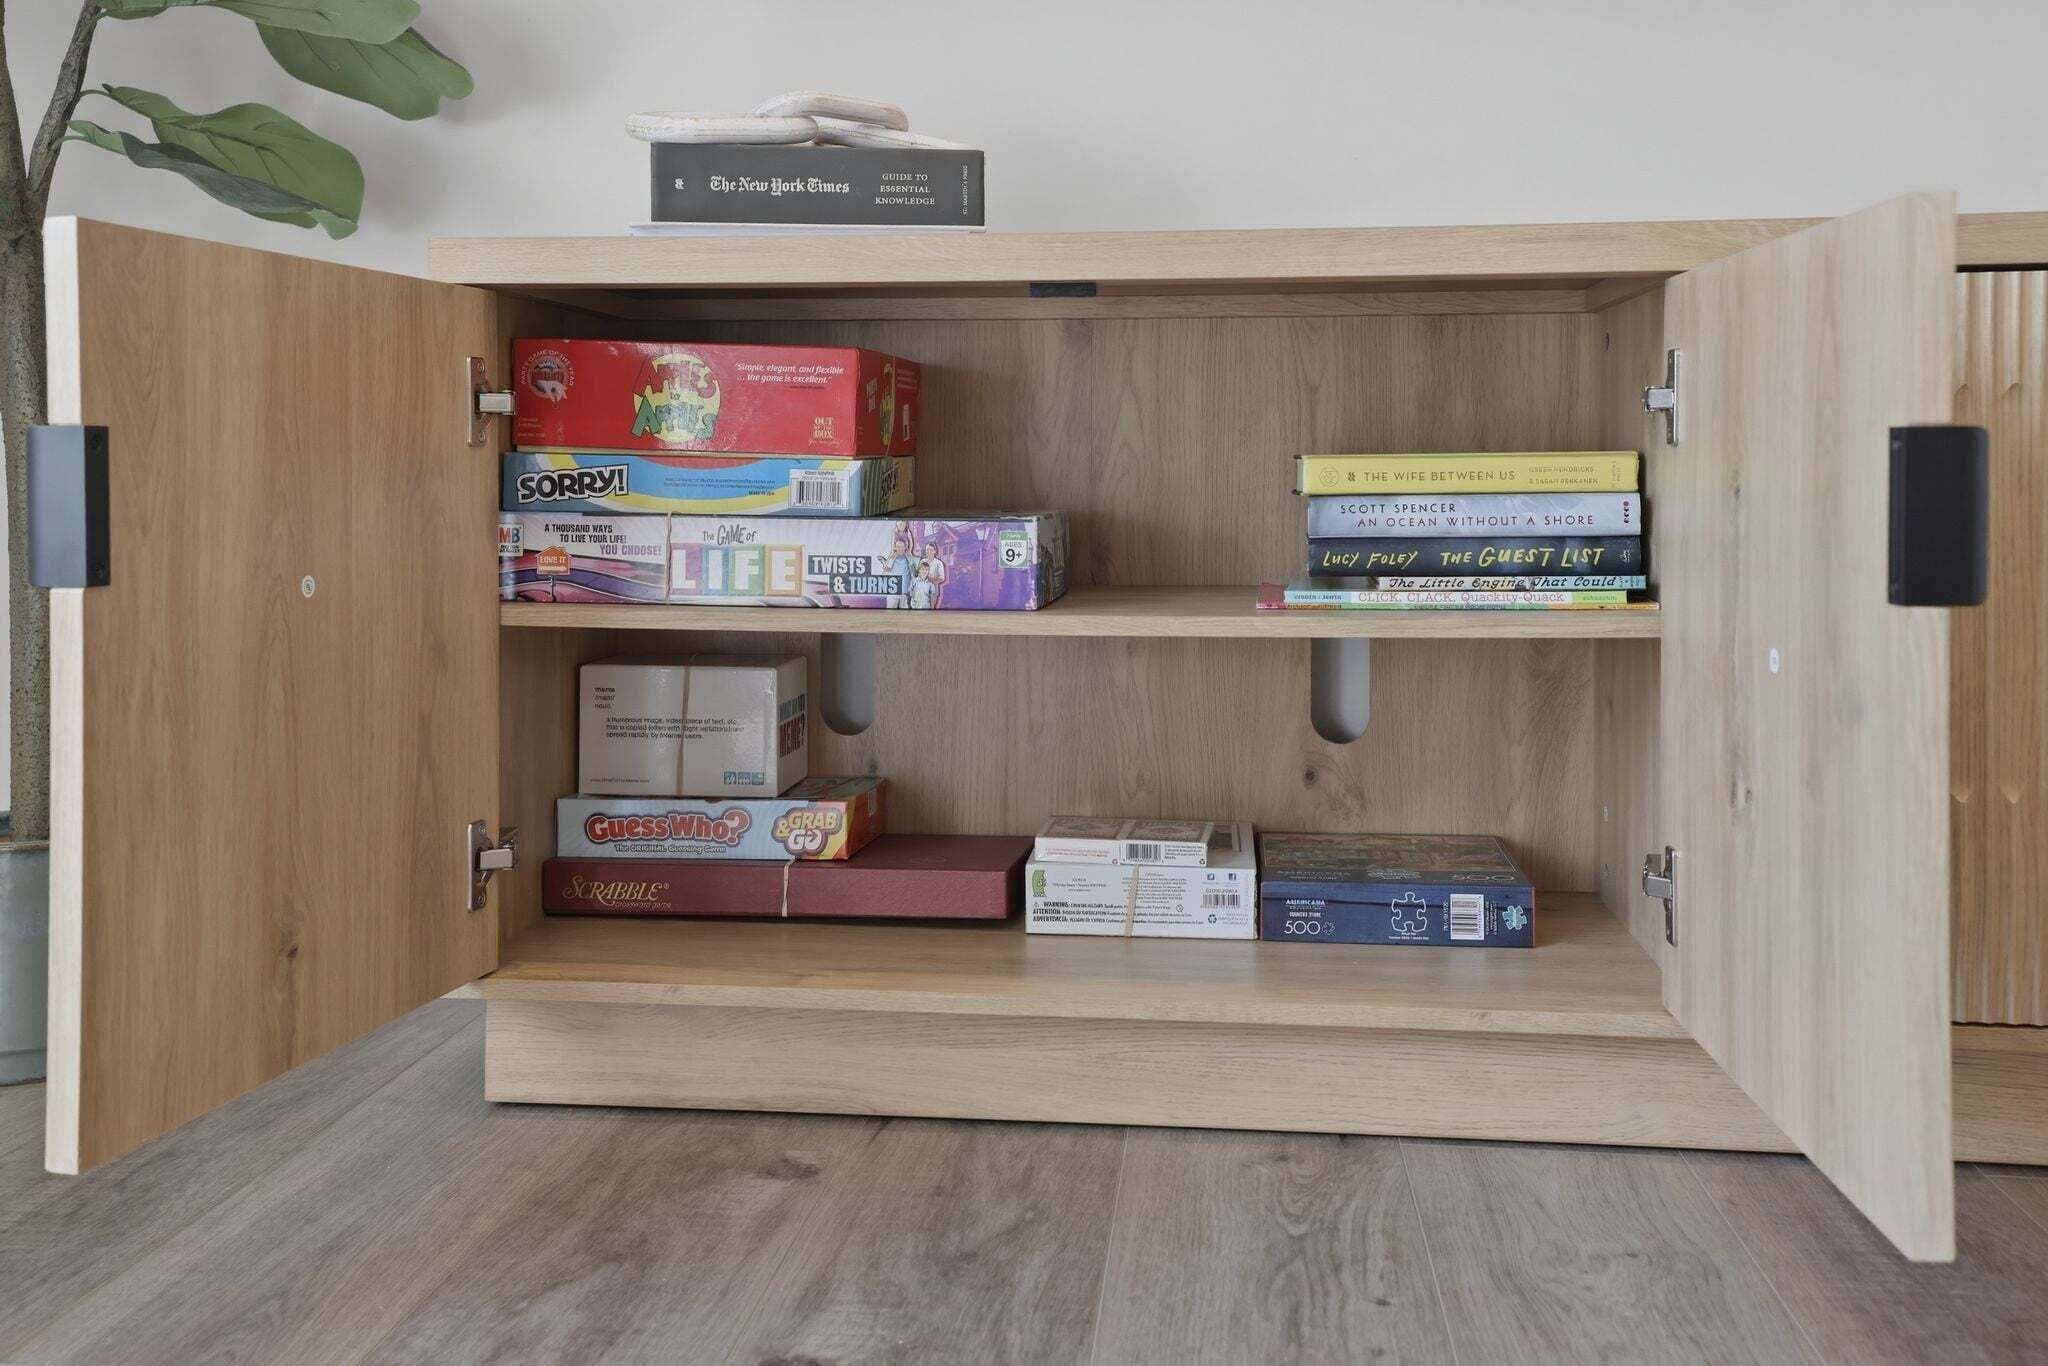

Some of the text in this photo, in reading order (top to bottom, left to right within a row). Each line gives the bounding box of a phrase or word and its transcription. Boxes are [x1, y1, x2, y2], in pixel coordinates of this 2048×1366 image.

[882, 173, 928, 181] GUIDE TO
[710, 175, 850, 196] The New York Times
[880, 185, 930, 193] ESSENTIAL
[875, 196, 935, 205] KNOWLEDGE
[798, 366, 814, 374] and
[815, 366, 844, 375] flexible
[814, 416, 833, 425] OUT
[813, 430, 833, 439] BOX
[1364, 472, 1388, 482] THE
[1394, 471, 1425, 481] WIFE
[1431, 471, 1494, 481] BETWEEN
[1499, 471, 1515, 481] US
[518, 466, 627, 503] SORRY!
[1340, 503, 1456, 514] SCOTT SPENCER
[1357, 515, 1594, 528] AN OCEAN WITHOUT A SHORE
[544, 524, 613, 533] A THOUSAND WAYS
[702, 524, 756, 545] The GAME of
[560, 534, 627, 543] TO LIVE YOUR LIFE!
[600, 545, 662, 556] YOU CHOOSE!
[1005, 548, 1023, 562] 9+
[560, 556, 567, 564] IT
[812, 556, 865, 574] TWISTS
[1323, 551, 1359, 568] LUCY
[1366, 550, 1418, 570] FOLEY
[1440, 551, 1472, 566] THE
[1478, 547, 1555, 568] GUEST
[1560, 547, 1605, 568] LIST
[674, 548, 797, 591] LIFE
[833, 576, 898, 593] & TURNS
[1389, 576, 1616, 590] The Little Engine That Could
[1461, 591, 1565, 604] Quackity-Quack
[587, 809, 750, 845] Guess Who?
[775, 812, 837, 837] & GRAB
[788, 829, 822, 850] GO
[1284, 920, 1321, 935] 500
